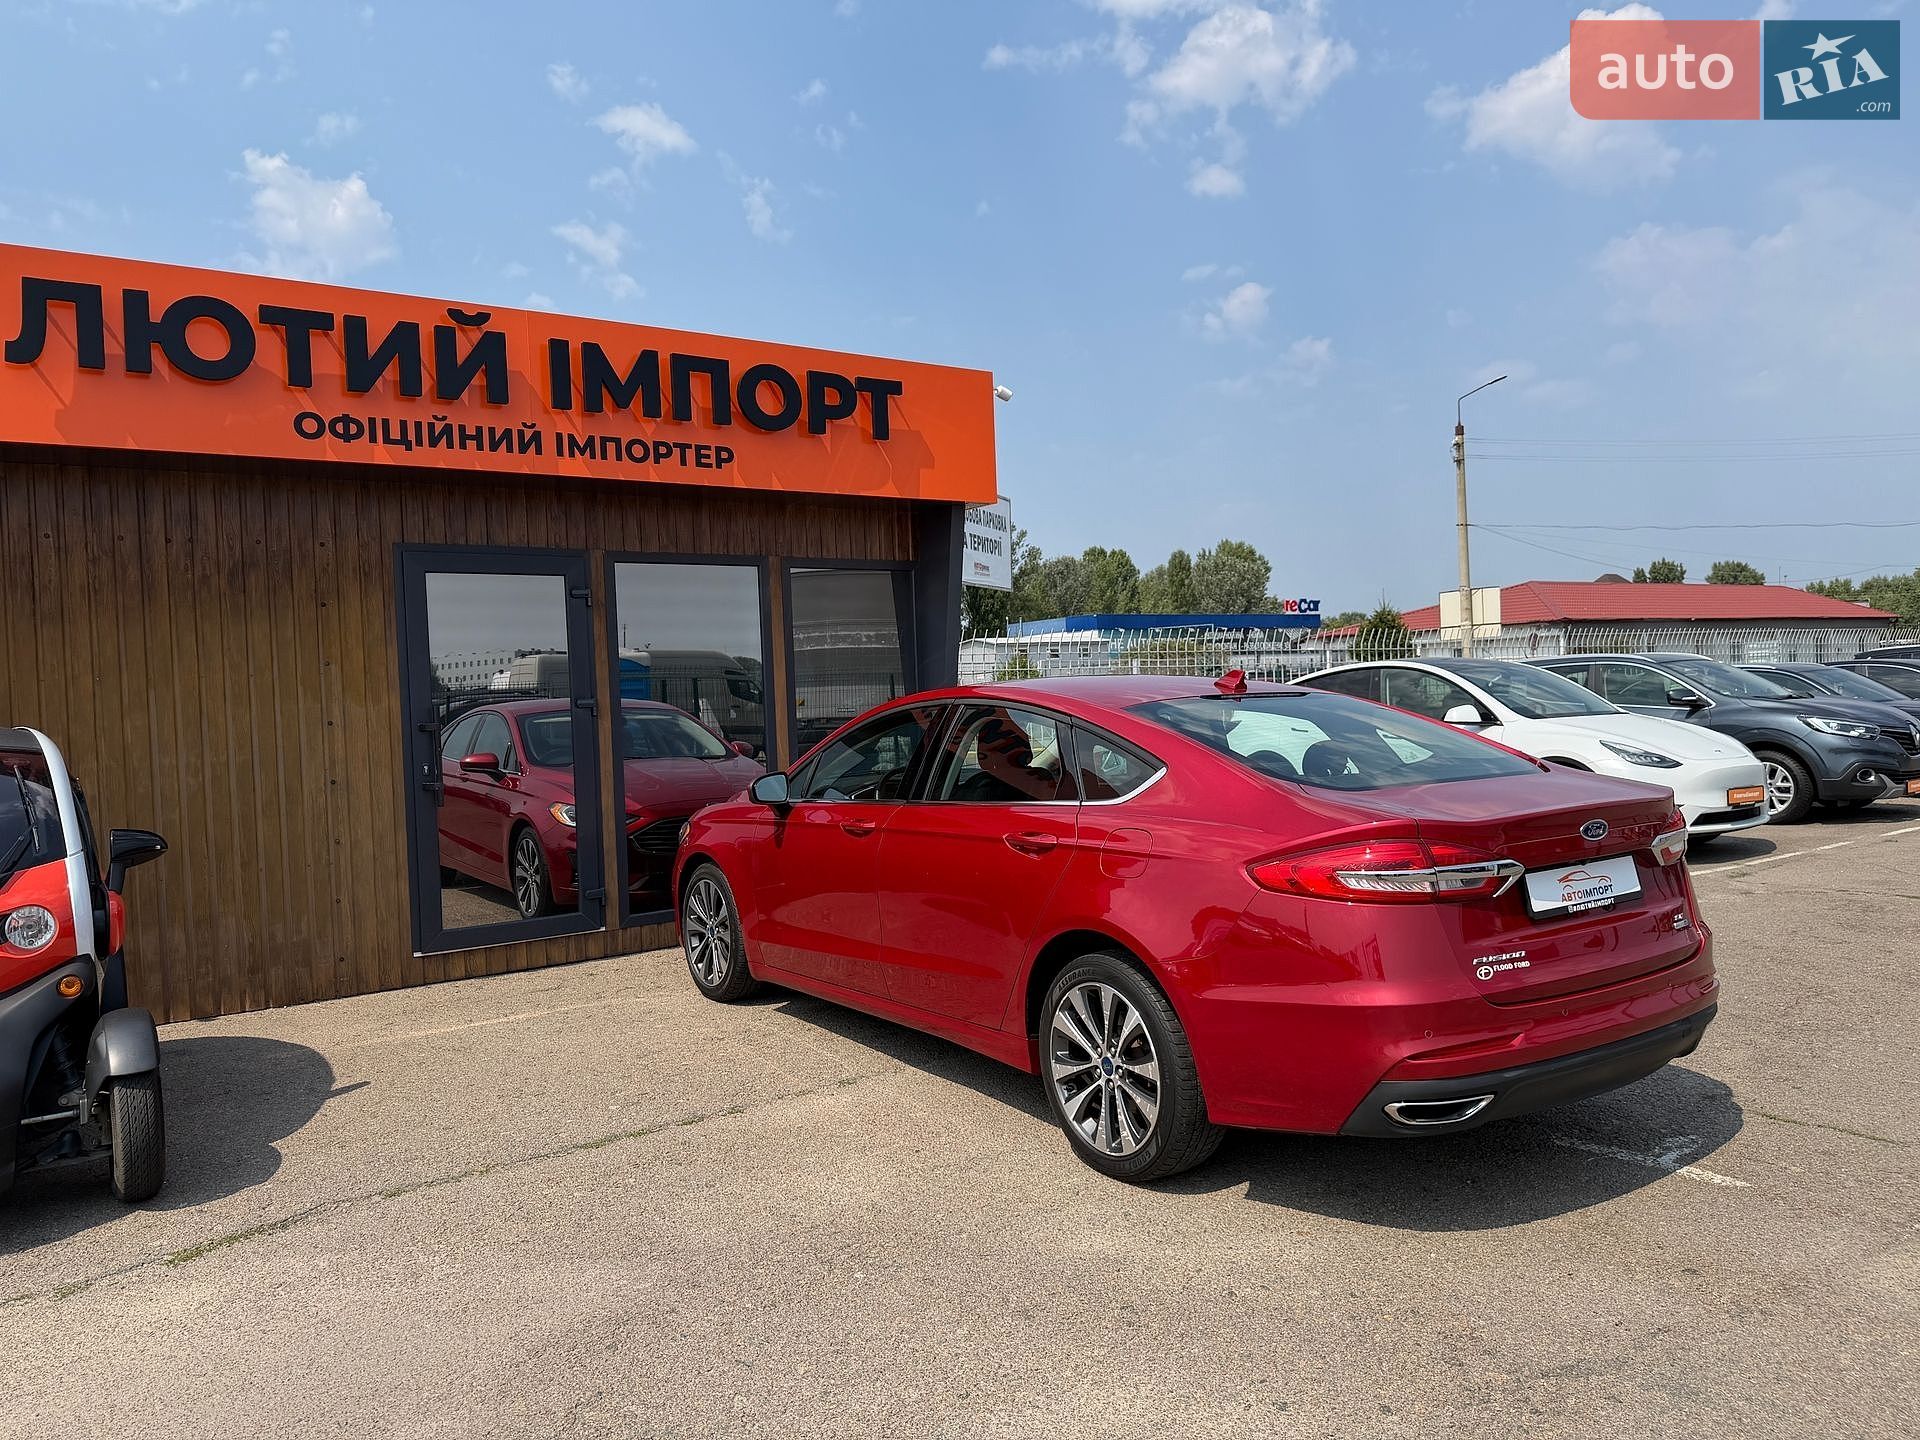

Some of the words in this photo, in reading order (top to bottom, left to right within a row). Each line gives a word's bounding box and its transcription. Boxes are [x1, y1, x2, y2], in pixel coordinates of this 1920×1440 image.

[4, 277, 511, 406] ЛЮТИЙ
[548, 338, 903, 441] ІМПОРТ
[293, 411, 544, 457] ОФІЦІЙНИЙ
[555, 432, 735, 470] ІМПОРТЕР
[983, 510, 1008, 533] ПАРКОВКА
[968, 533, 1002, 557] ТЕРИТОРІЇ
[1561, 884, 1614, 903] АВТОІМПОРТ
[1493, 963, 1514, 972] FLOOD
[1514, 961, 1530, 969] FORD
